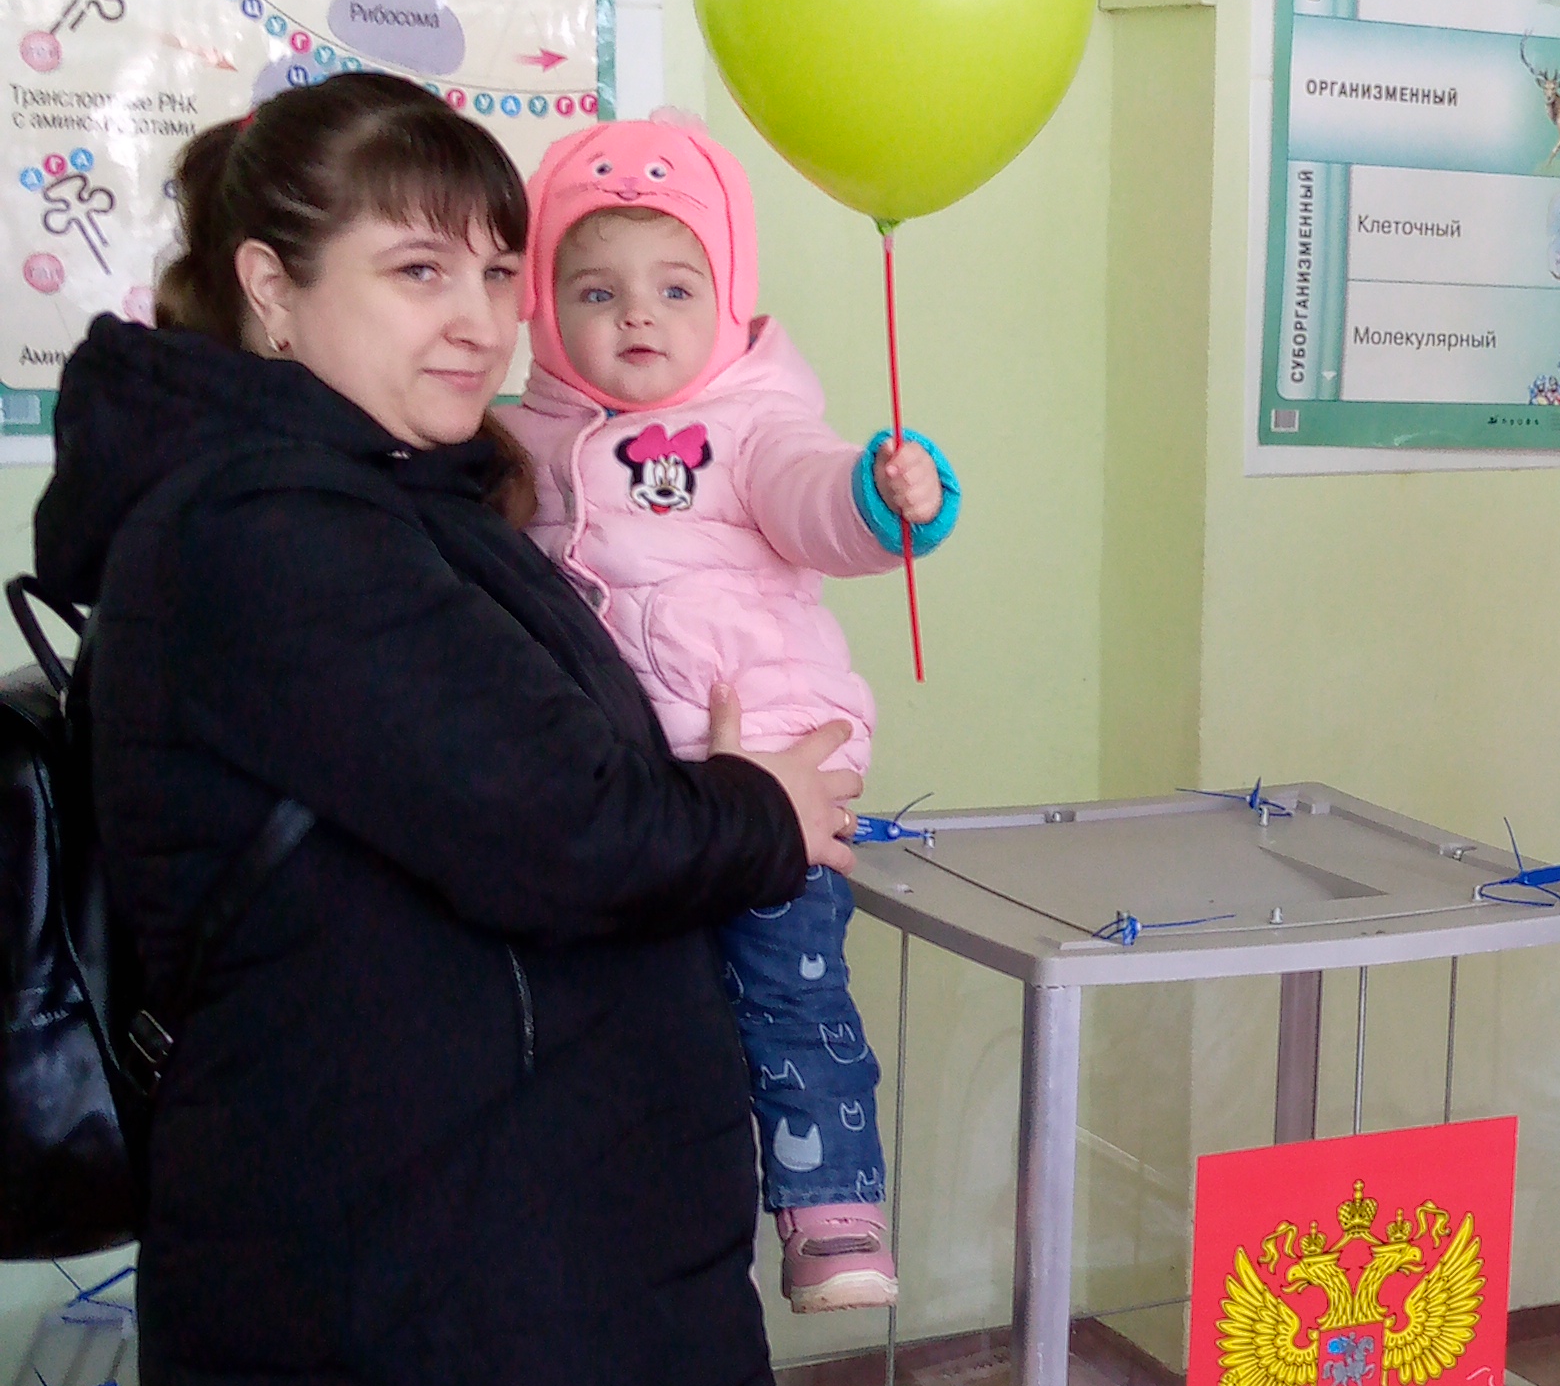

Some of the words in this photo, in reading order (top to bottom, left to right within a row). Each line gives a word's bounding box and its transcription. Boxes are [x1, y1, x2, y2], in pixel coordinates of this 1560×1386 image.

[349, 1, 441, 29] Рибосома
[158, 91, 199, 115] РНК
[1306, 78, 1459, 106] ОРГАНИЗМЕННЫЙ
[1356, 214, 1462, 239] Клеточный
[1291, 170, 1315, 383] СУБОРГАНИЗМЕННЫЙ
[1353, 326, 1497, 351] Молекулярный
